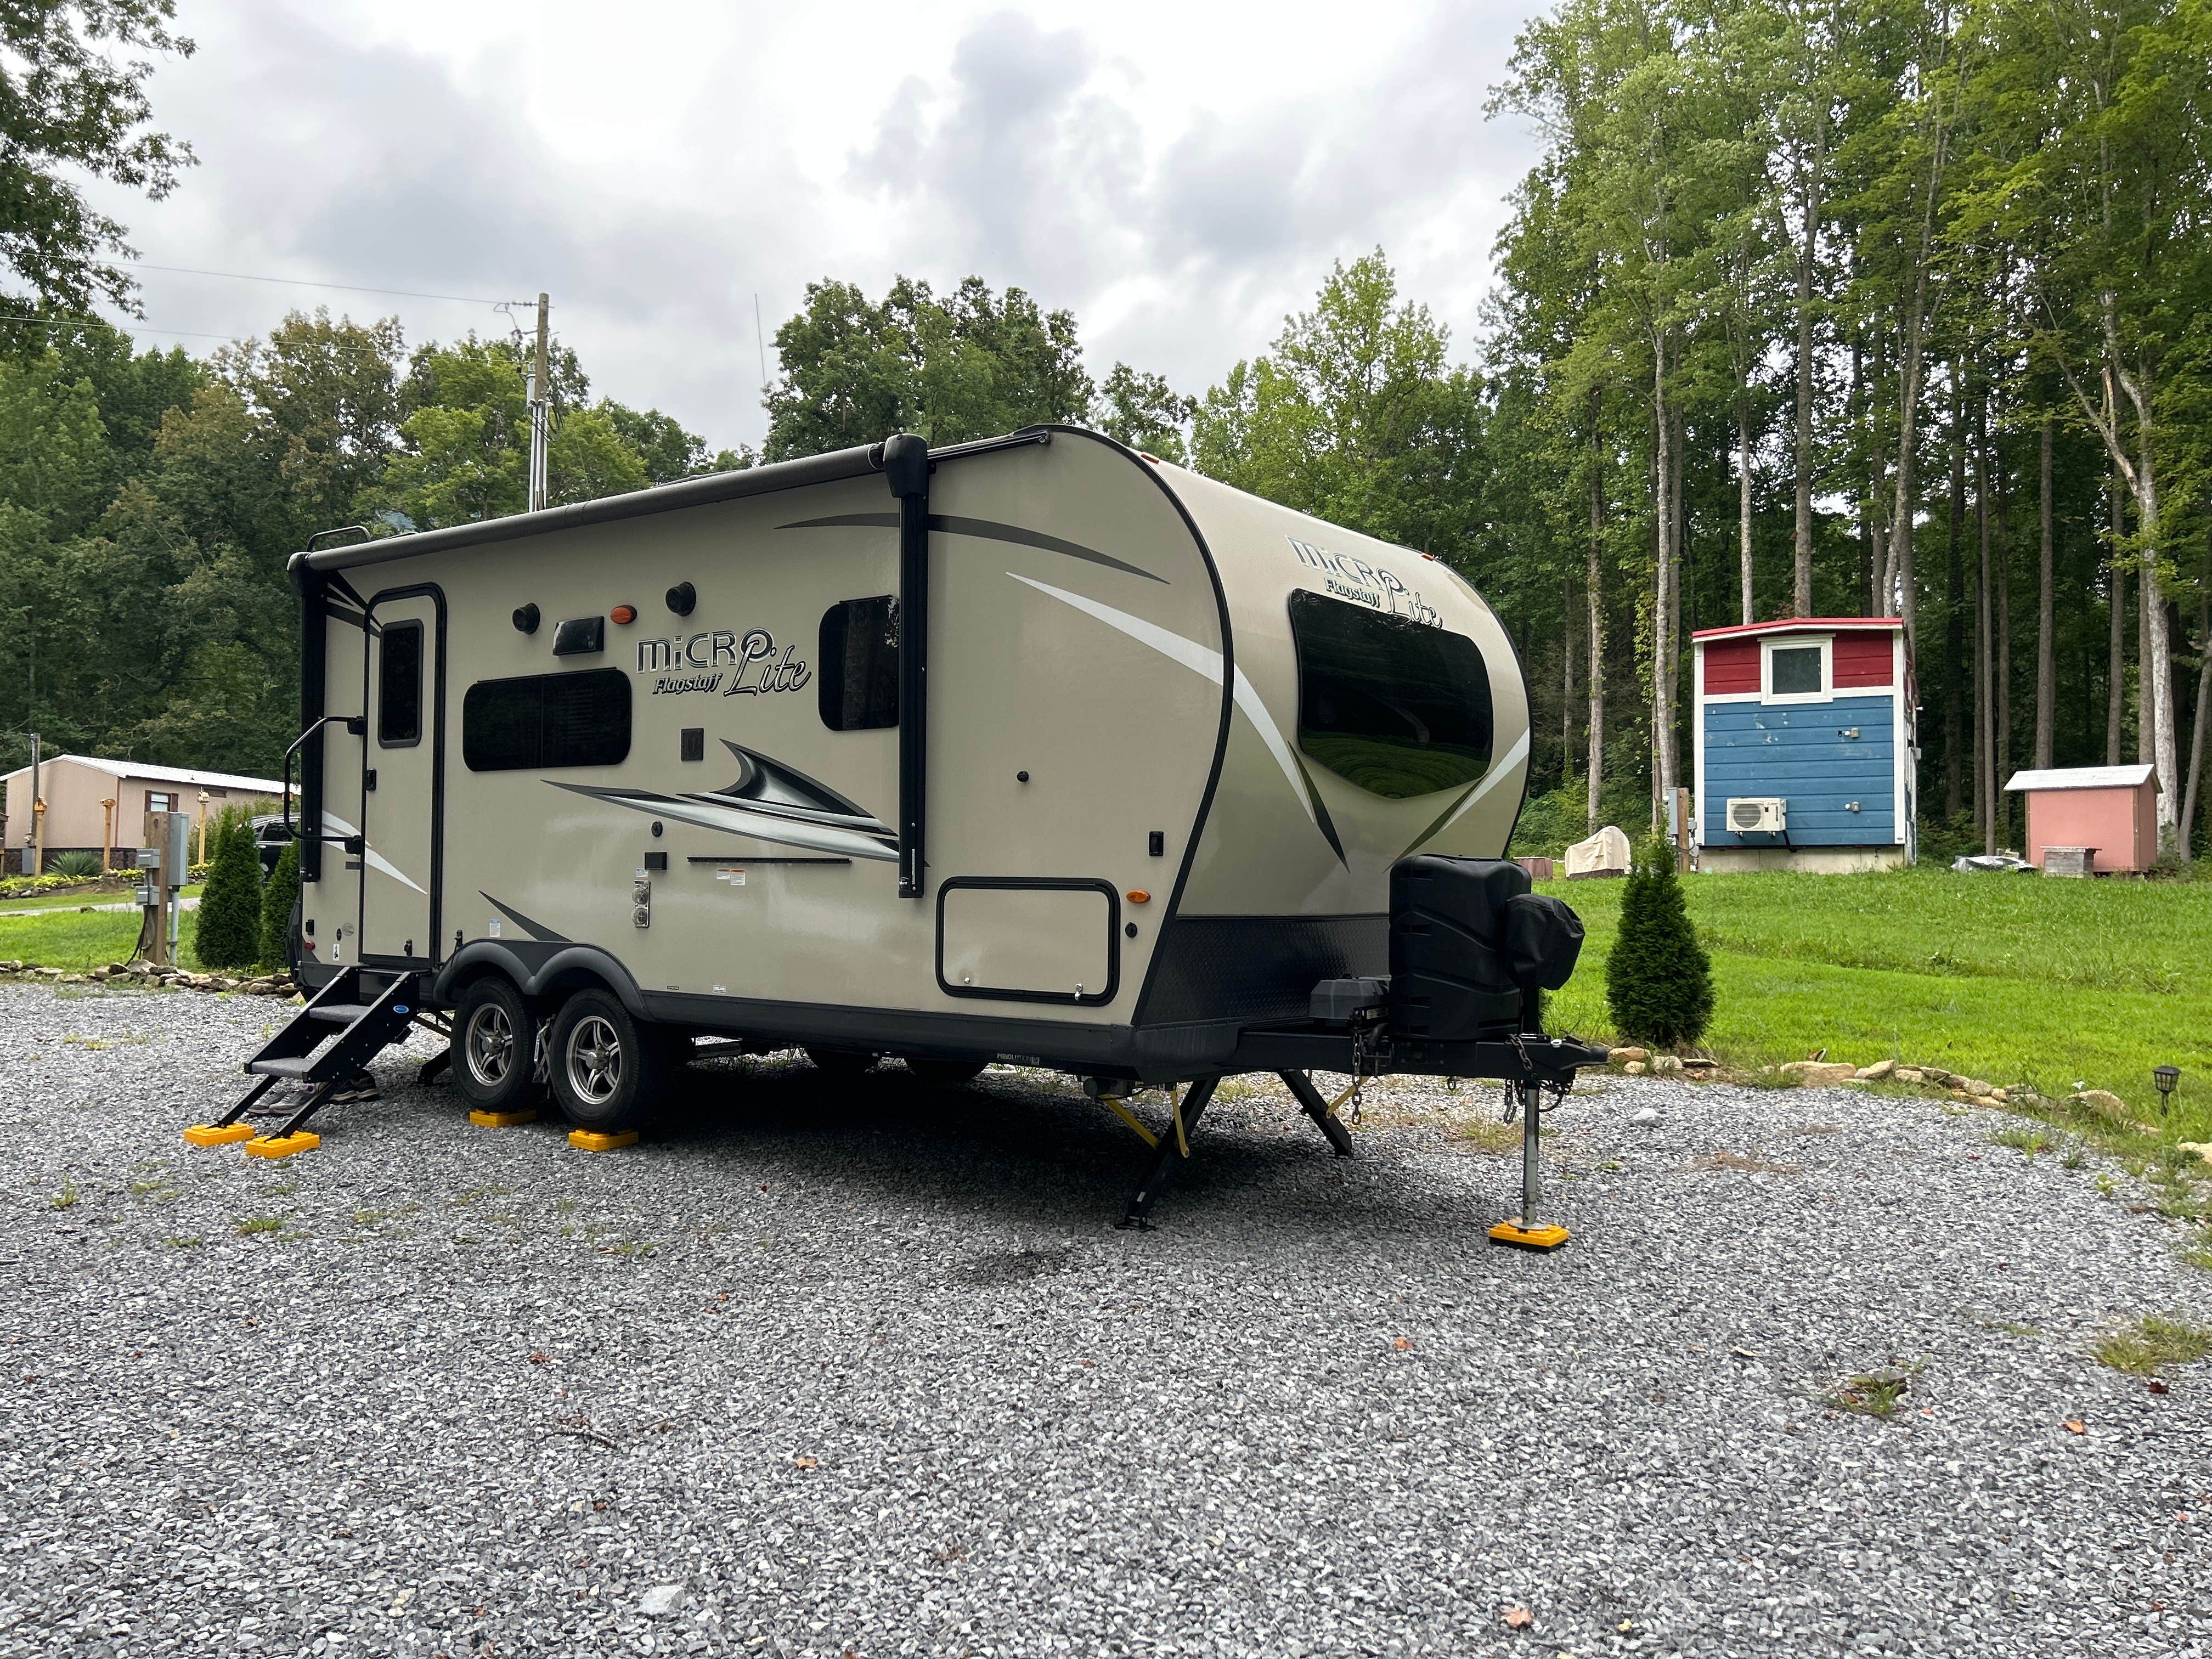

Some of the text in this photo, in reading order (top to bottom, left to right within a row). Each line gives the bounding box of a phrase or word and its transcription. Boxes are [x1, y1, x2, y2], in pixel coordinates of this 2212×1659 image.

[1323, 577, 1443, 629] Flagstaff Lite
[652, 639, 812, 697] Flagstaff Lite
